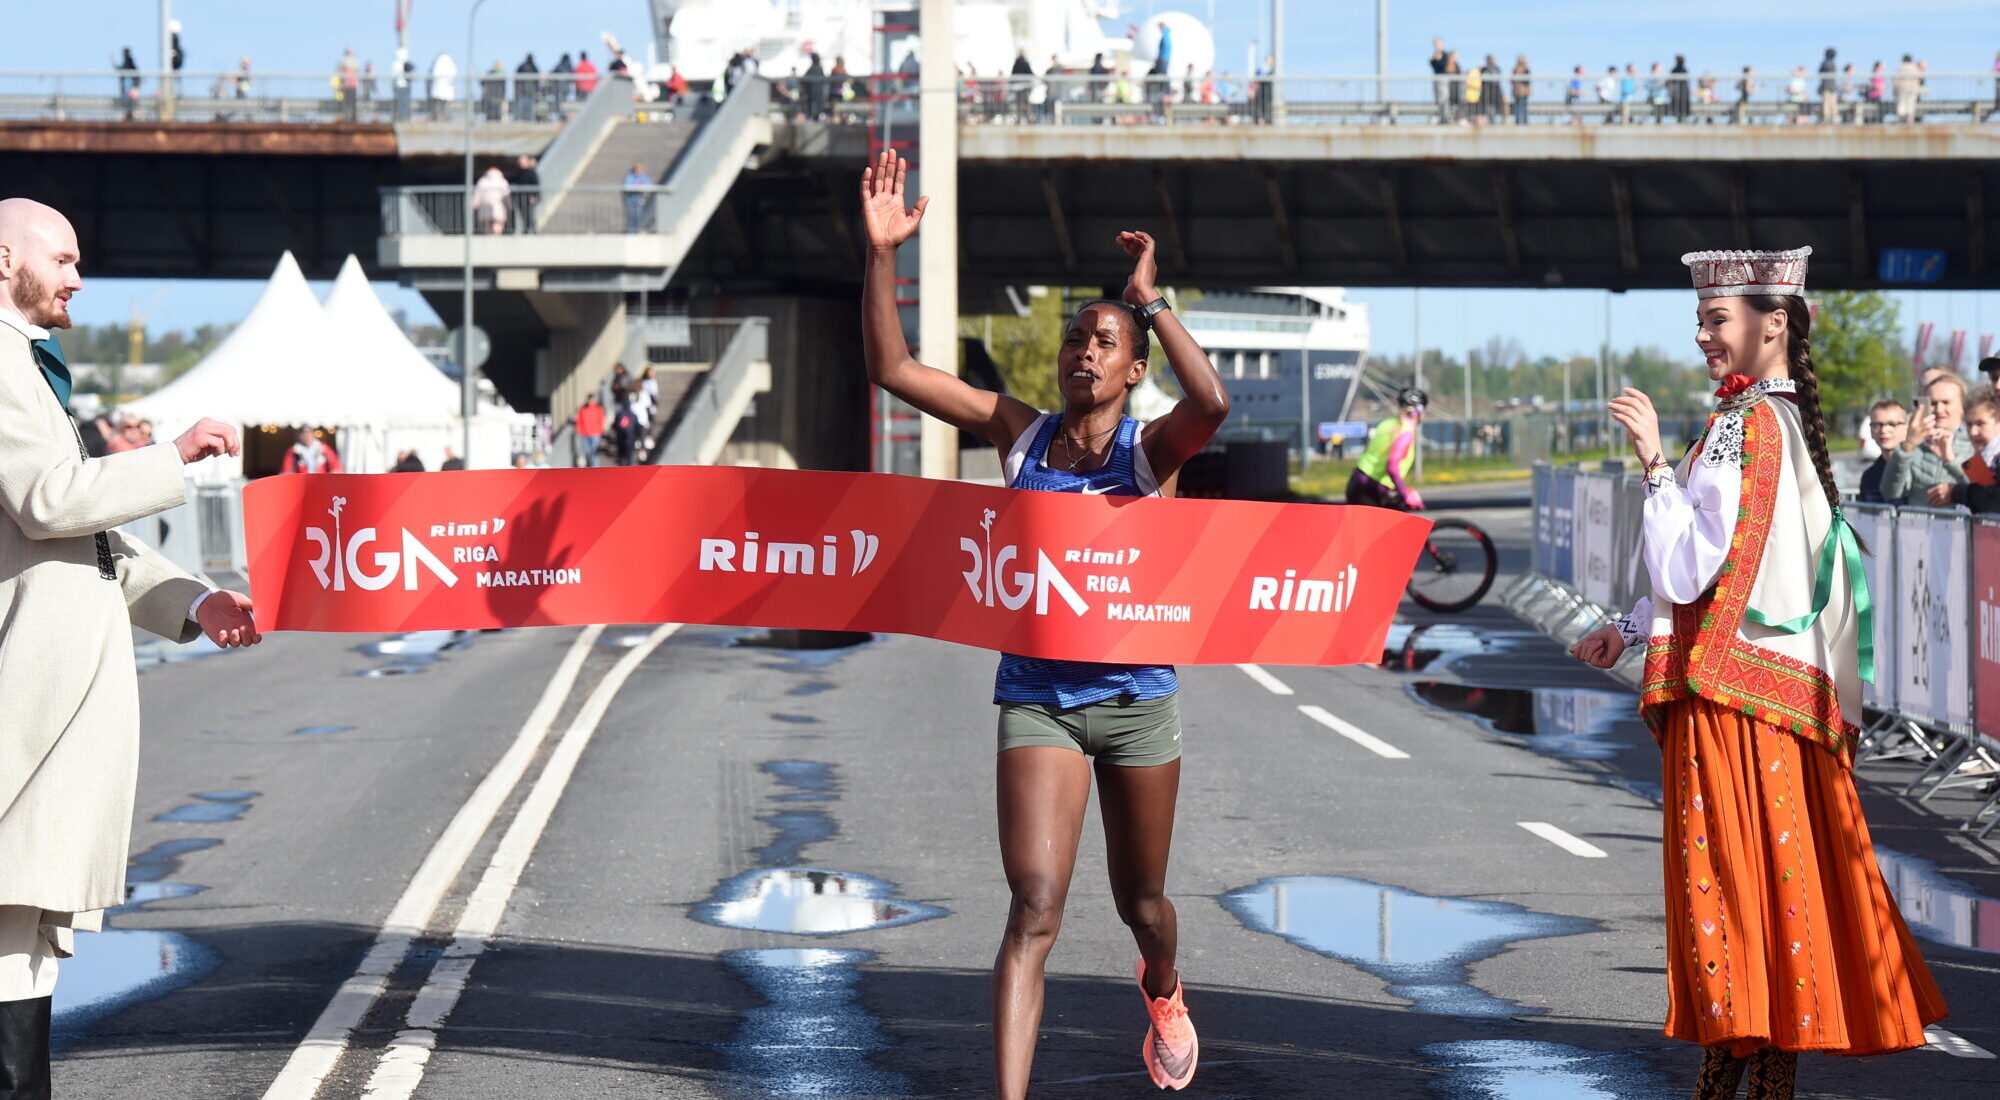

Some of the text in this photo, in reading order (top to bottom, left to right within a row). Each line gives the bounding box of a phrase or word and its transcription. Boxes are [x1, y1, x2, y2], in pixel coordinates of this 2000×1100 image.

[430, 520, 488, 537] Rimi
[453, 546, 499, 563] RIGA
[698, 531, 837, 577] Rimi
[1065, 548, 1124, 565] Rimi
[476, 568, 581, 588] MARATHON
[1086, 575, 1131, 593] RIGA
[1249, 569, 1345, 612] Rimi
[1107, 603, 1190, 622] MARATHON
